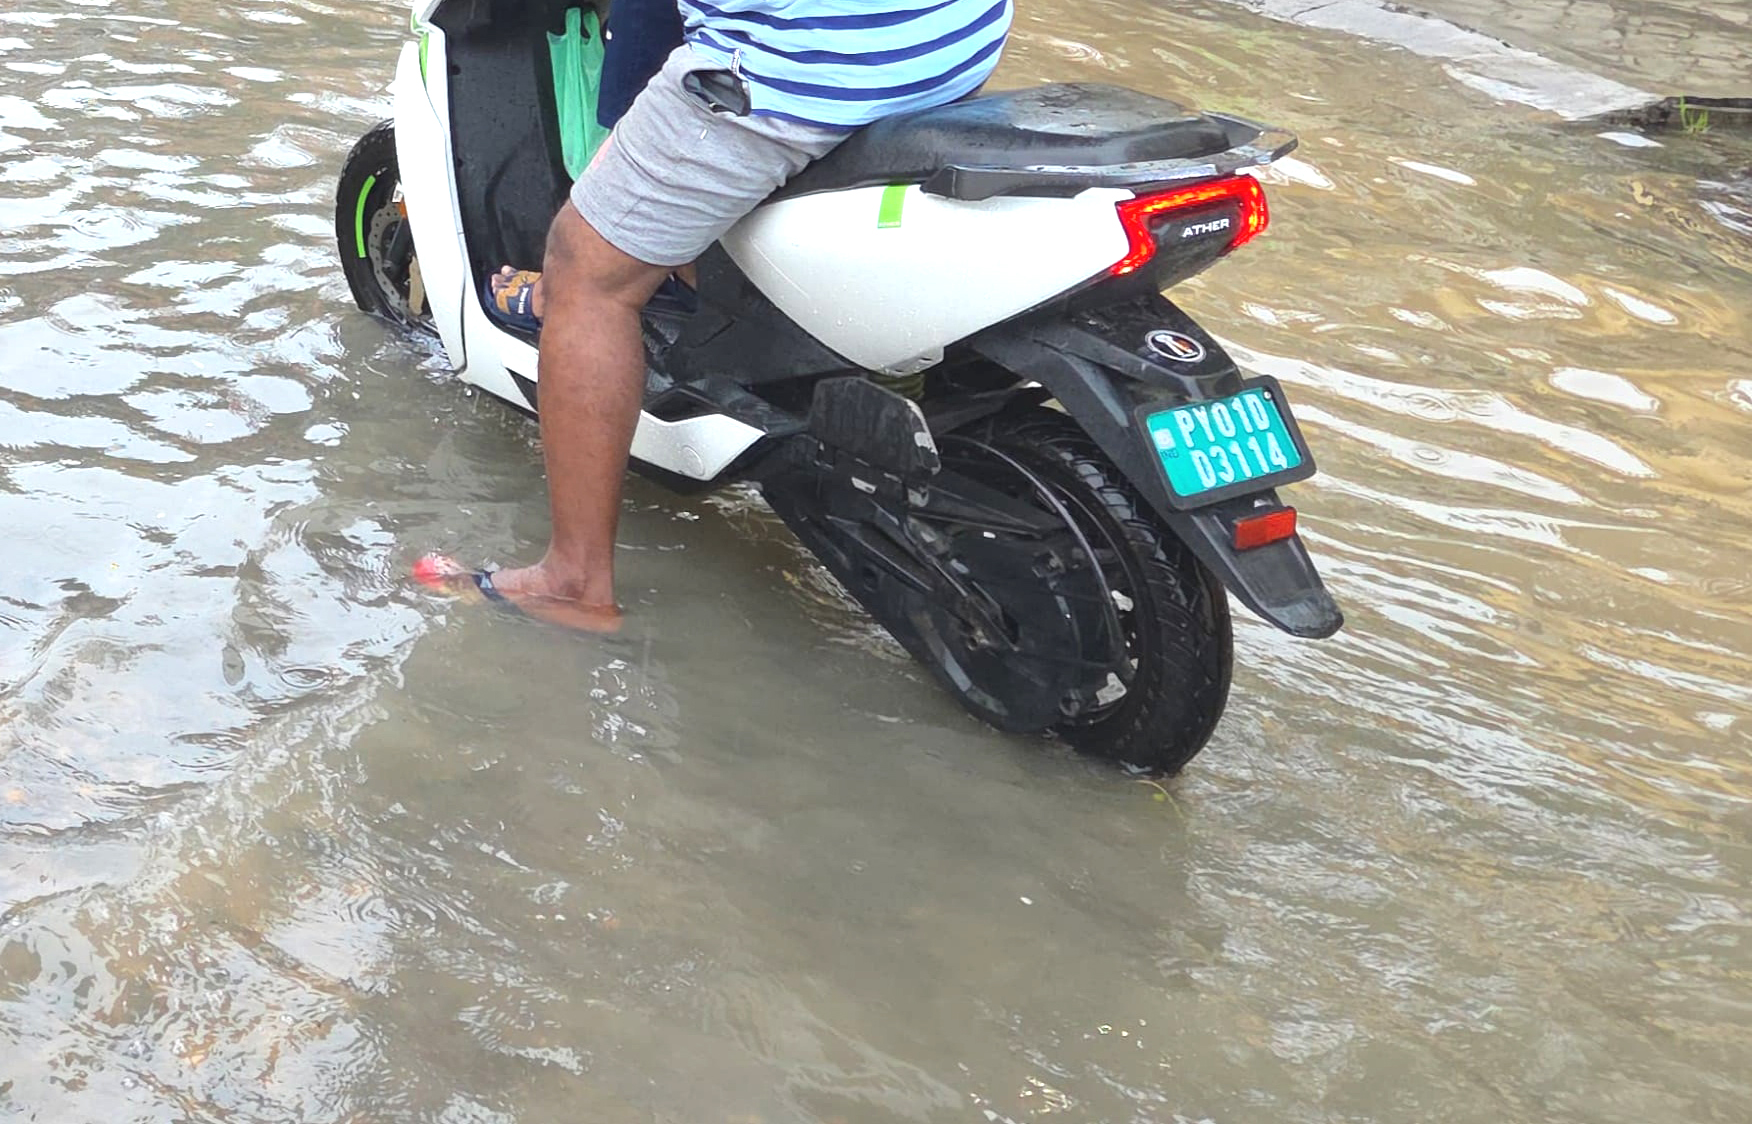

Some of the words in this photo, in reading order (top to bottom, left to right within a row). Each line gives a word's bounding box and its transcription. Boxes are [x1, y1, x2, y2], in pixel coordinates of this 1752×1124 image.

[1182, 218, 1230, 238] ATHER
[1173, 393, 1270, 448] PY01D
[1189, 430, 1288, 489] D3114
